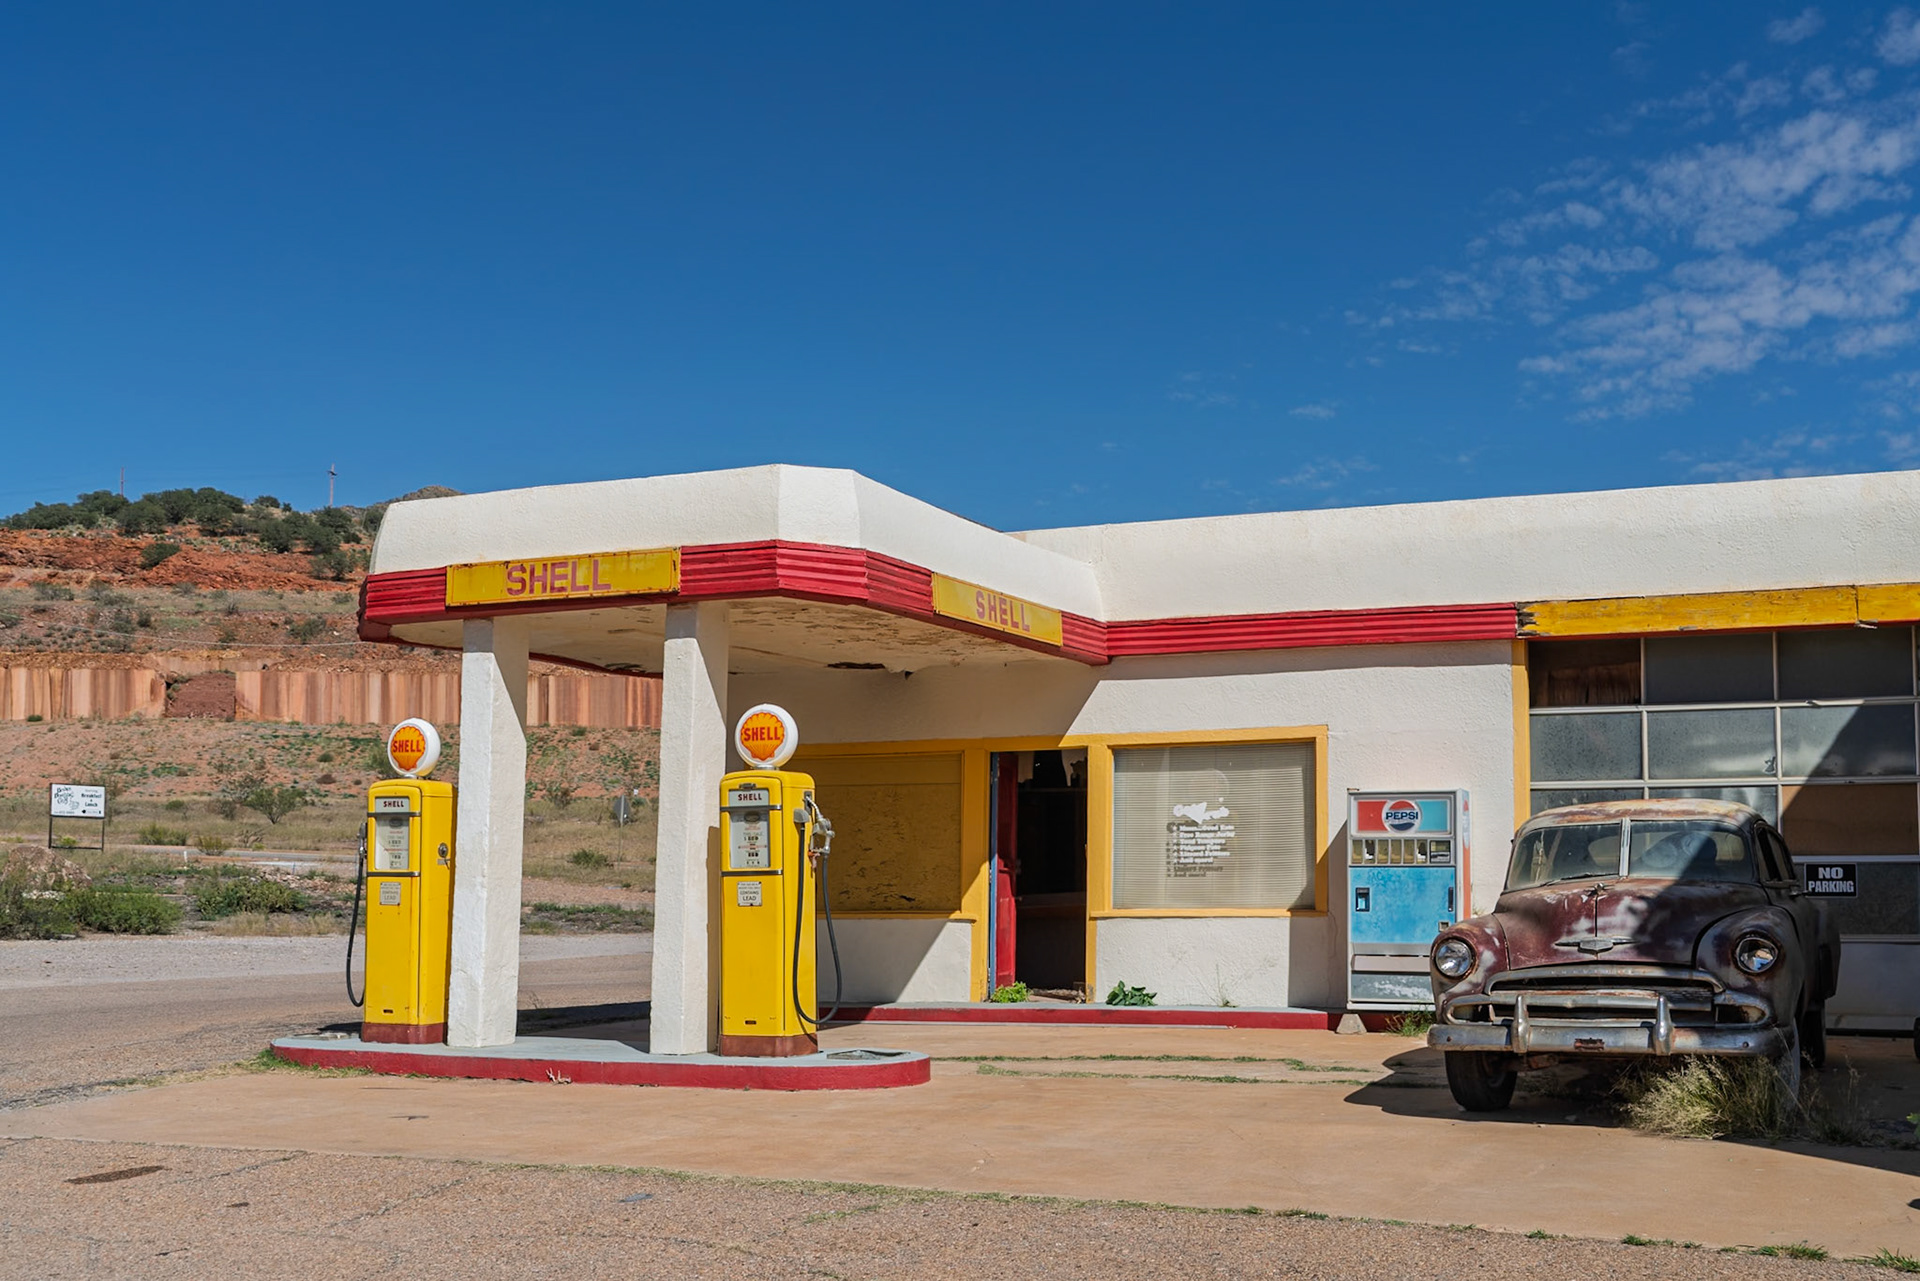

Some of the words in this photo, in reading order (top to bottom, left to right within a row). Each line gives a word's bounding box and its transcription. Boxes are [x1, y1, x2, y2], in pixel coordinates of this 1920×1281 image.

[506, 559, 611, 596] SHELL
[975, 590, 1030, 632] SHELL
[743, 726, 780, 741] SHELL
[393, 739, 421, 752] SHELL
[738, 793, 762, 801] SHELL
[383, 800, 404, 808] SHELL
[1386, 811, 1418, 820] PEPSI
[1818, 867, 1843, 879] NO
[1808, 881, 1854, 892] PARKING
